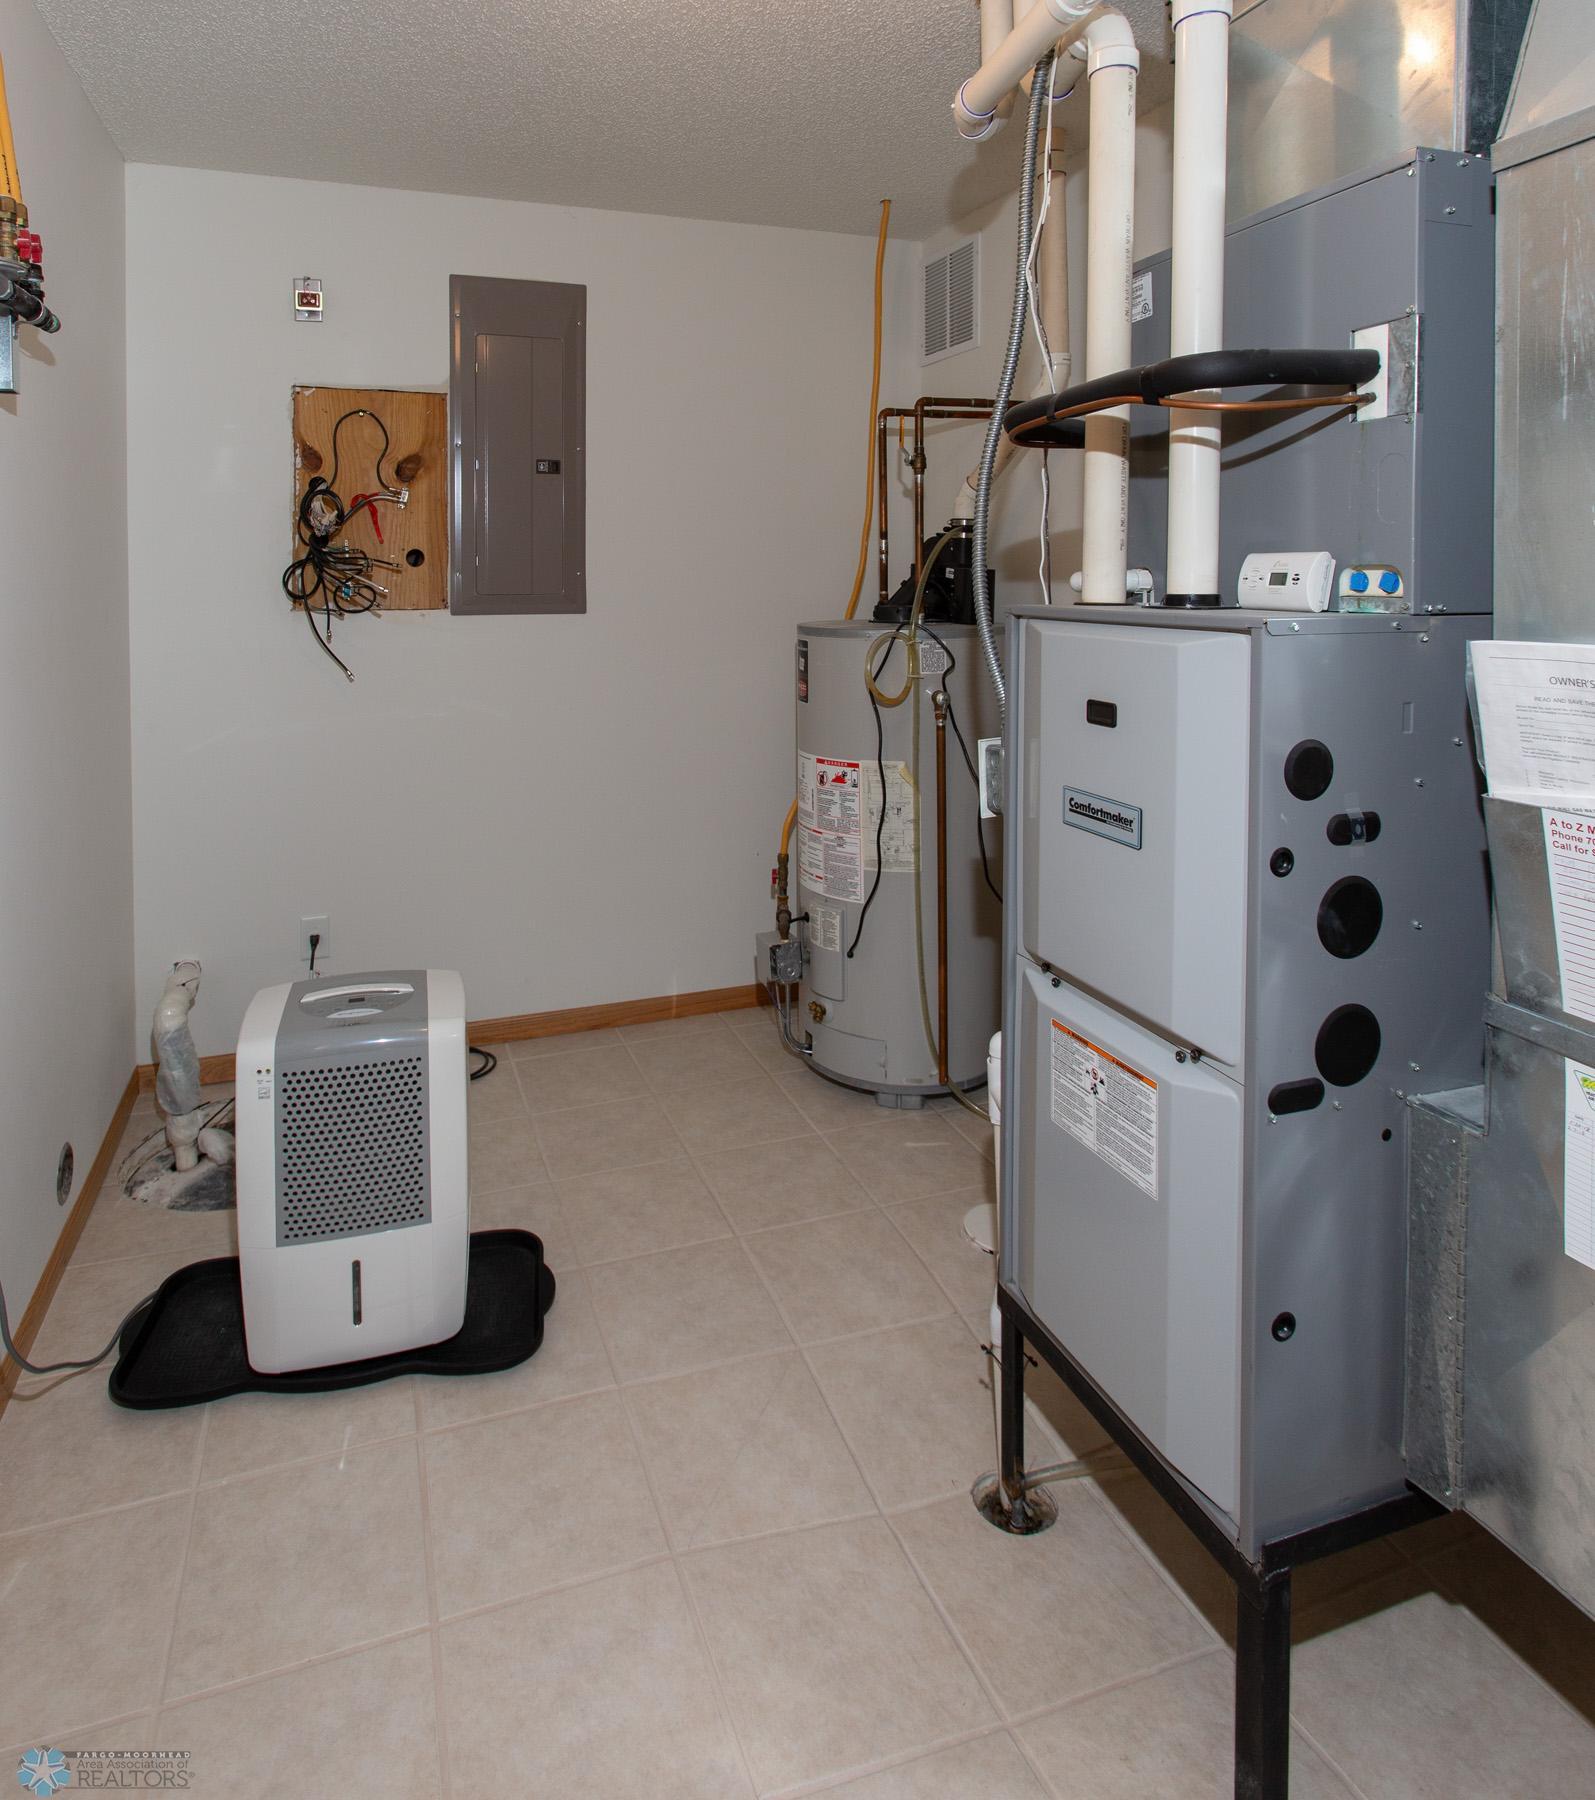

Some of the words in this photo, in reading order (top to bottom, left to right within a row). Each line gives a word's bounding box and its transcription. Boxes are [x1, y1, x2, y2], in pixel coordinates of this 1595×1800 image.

[1549, 676, 1595, 689] OWNER'S
[1068, 797, 1134, 827] Comfortmaker
[1550, 817, 1558, 827] A
[1561, 820, 1573, 830] to
[1576, 822, 1584, 832] Z
[1551, 829, 1583, 843] Phone
[1552, 840, 1572, 851] Call
[1574, 844, 1588, 855] for
